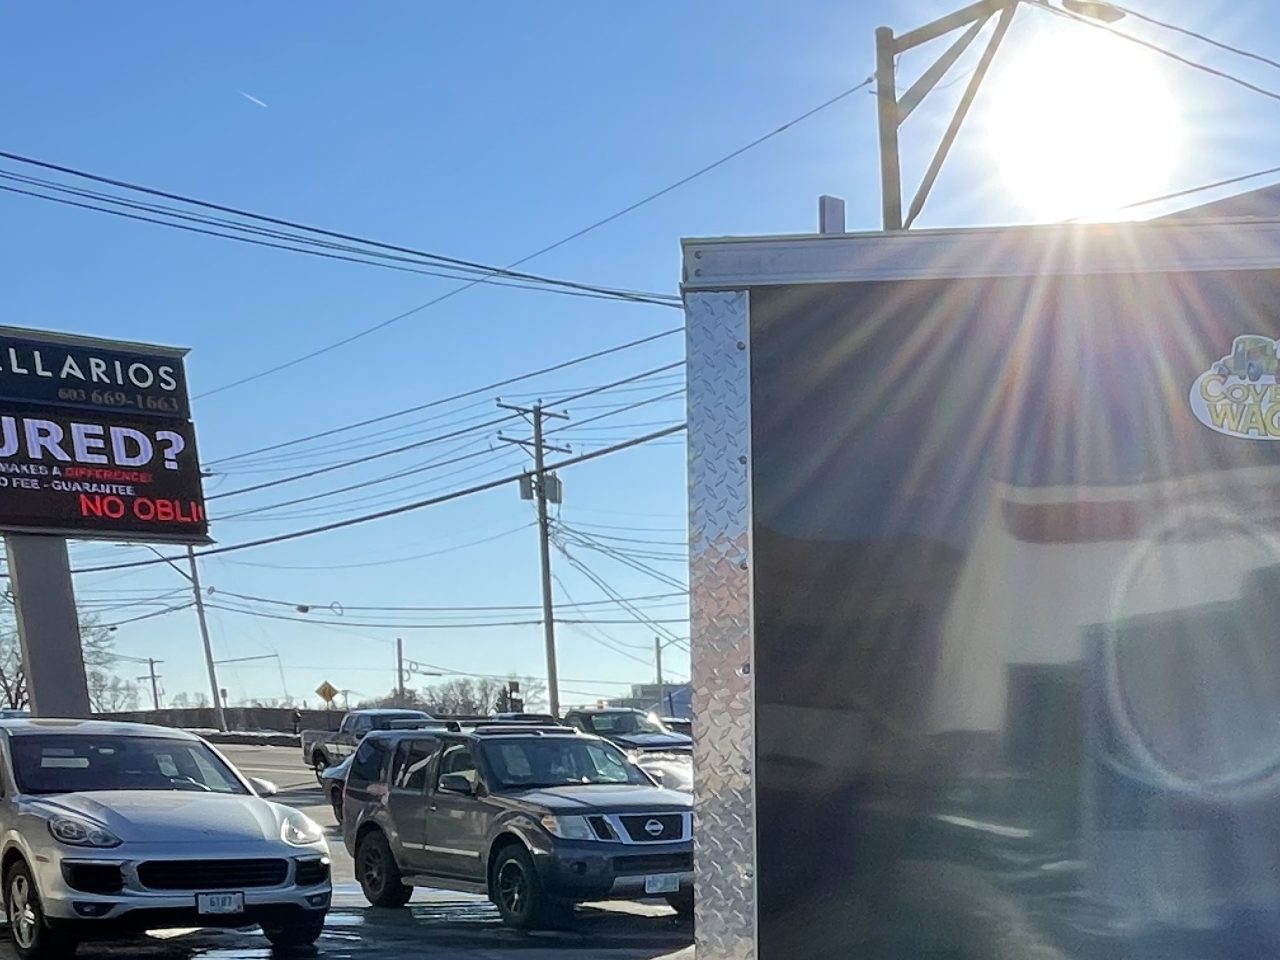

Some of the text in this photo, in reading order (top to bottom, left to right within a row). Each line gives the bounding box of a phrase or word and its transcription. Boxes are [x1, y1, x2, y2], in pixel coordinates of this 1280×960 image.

[0, 347, 178, 391] LLARIOS
[12, 477, 40, 490] FEE
[79, 493, 204, 522] NO OBLI
